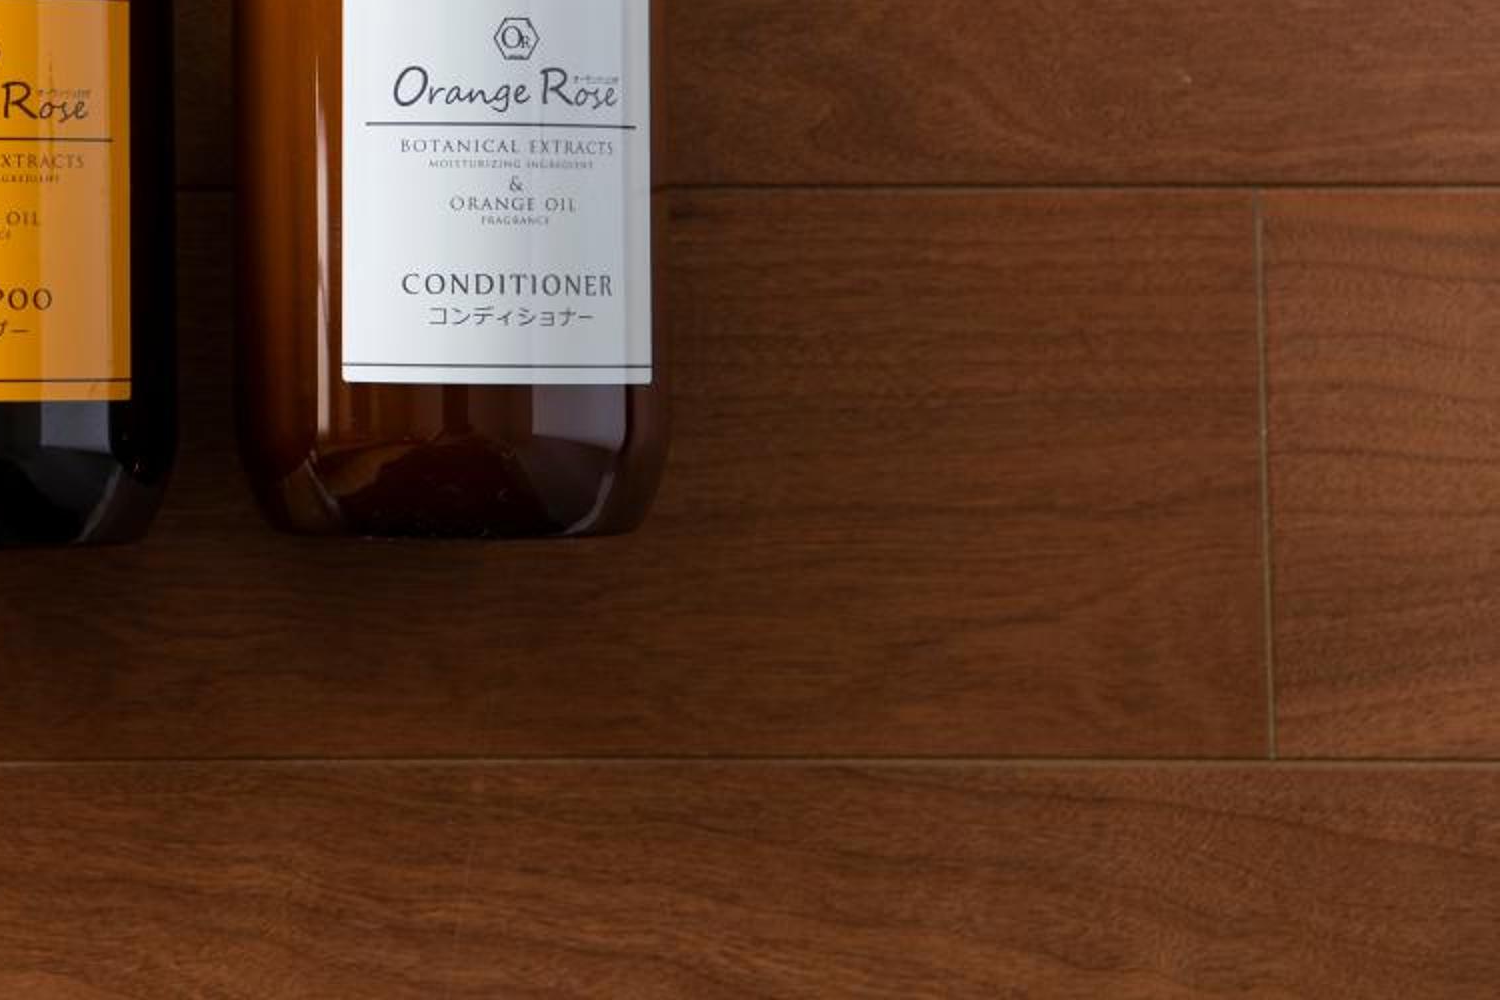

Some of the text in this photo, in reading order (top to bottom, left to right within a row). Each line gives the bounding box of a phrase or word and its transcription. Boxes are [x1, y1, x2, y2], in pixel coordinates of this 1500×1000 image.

[394, 66, 618, 112] Orange Rose
[2, 81, 88, 123] Rose
[401, 139, 613, 156] BOTANICAL EXTRACTS
[428, 160, 521, 168] MOISTURIZING
[509, 176, 522, 191] &
[450, 197, 576, 212] ORANGE OIL
[6, 211, 40, 225] OIL
[481, 216, 550, 225] FRAGRANCE
[401, 273, 612, 297] CONDITIONER
[428, 306, 593, 326] コンディショナー
